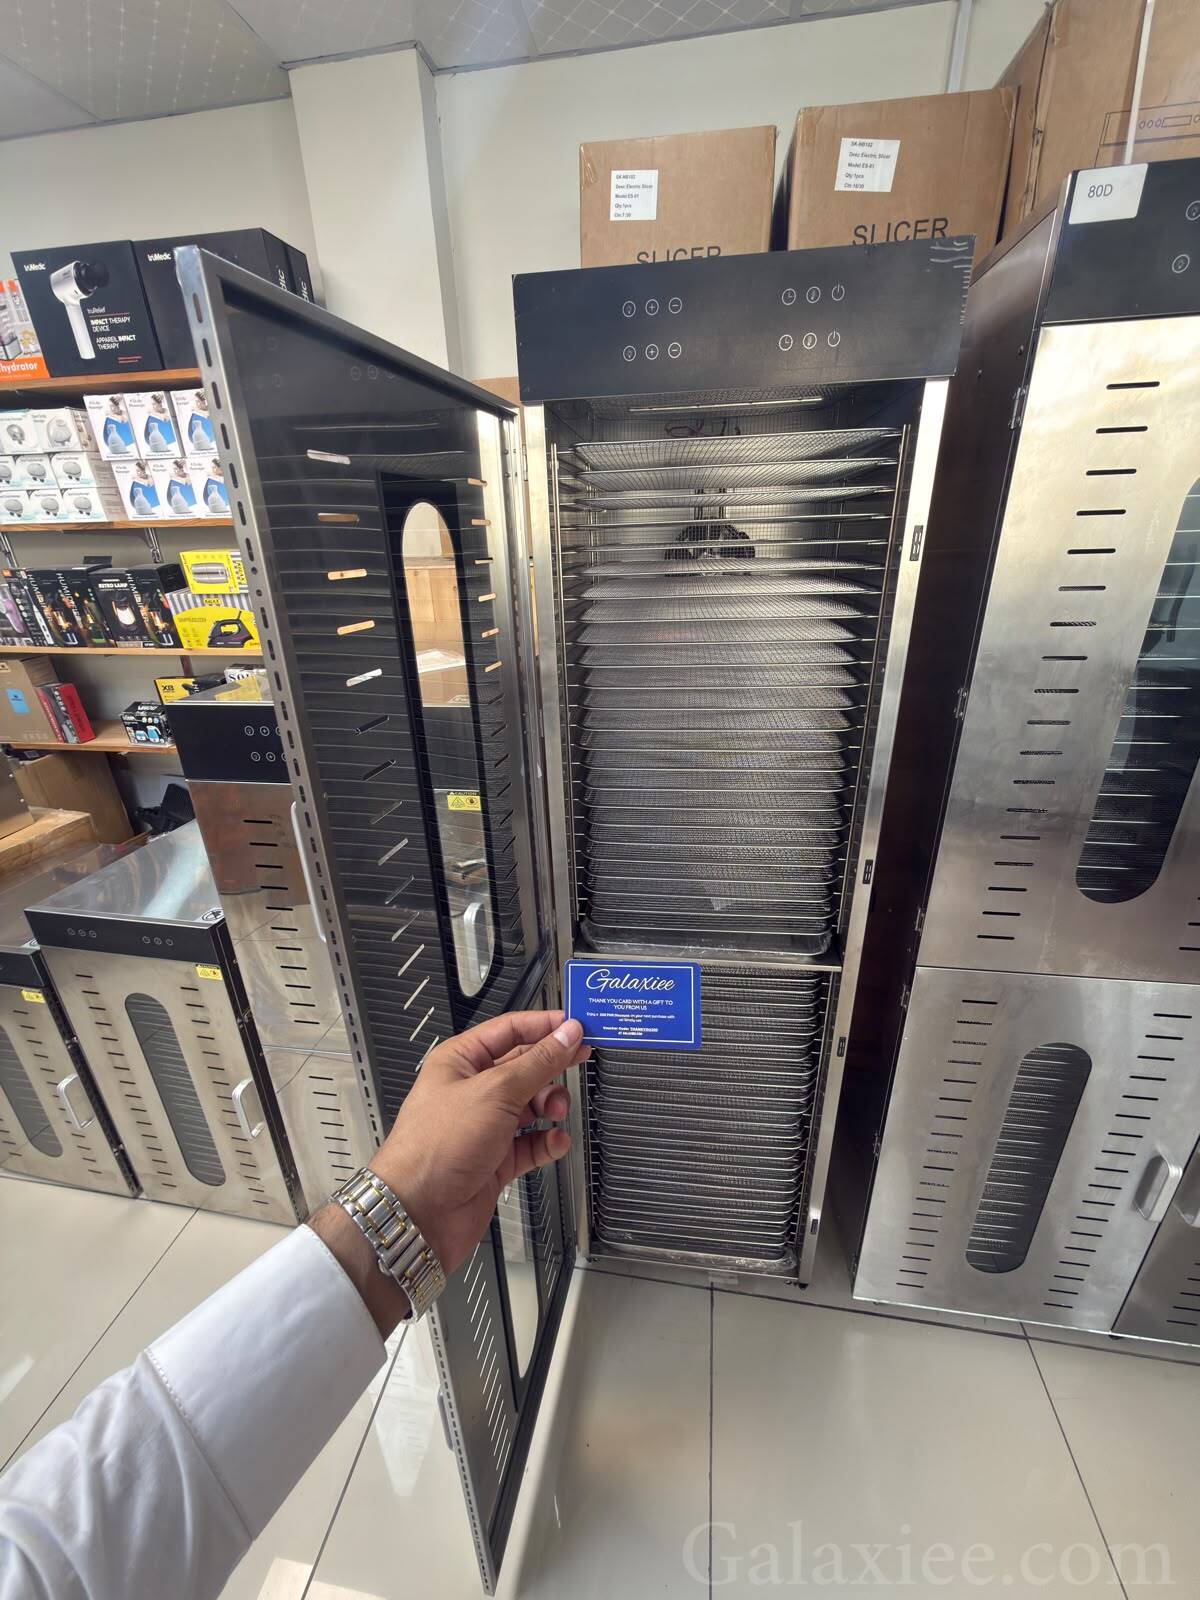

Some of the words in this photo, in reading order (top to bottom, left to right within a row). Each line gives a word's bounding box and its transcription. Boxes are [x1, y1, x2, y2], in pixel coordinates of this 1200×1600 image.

[1087, 183, 1113, 198] 80D
[852, 217, 949, 246] SLICER
[90, 317, 109, 326] IMPACT
[108, 316, 131, 325] THERAPY
[92, 324, 111, 333] DEVICE
[117, 334, 136, 342] IMPACT
[97, 342, 119, 350] THERAPY
[586, 968, 676, 993] Galaxiee
